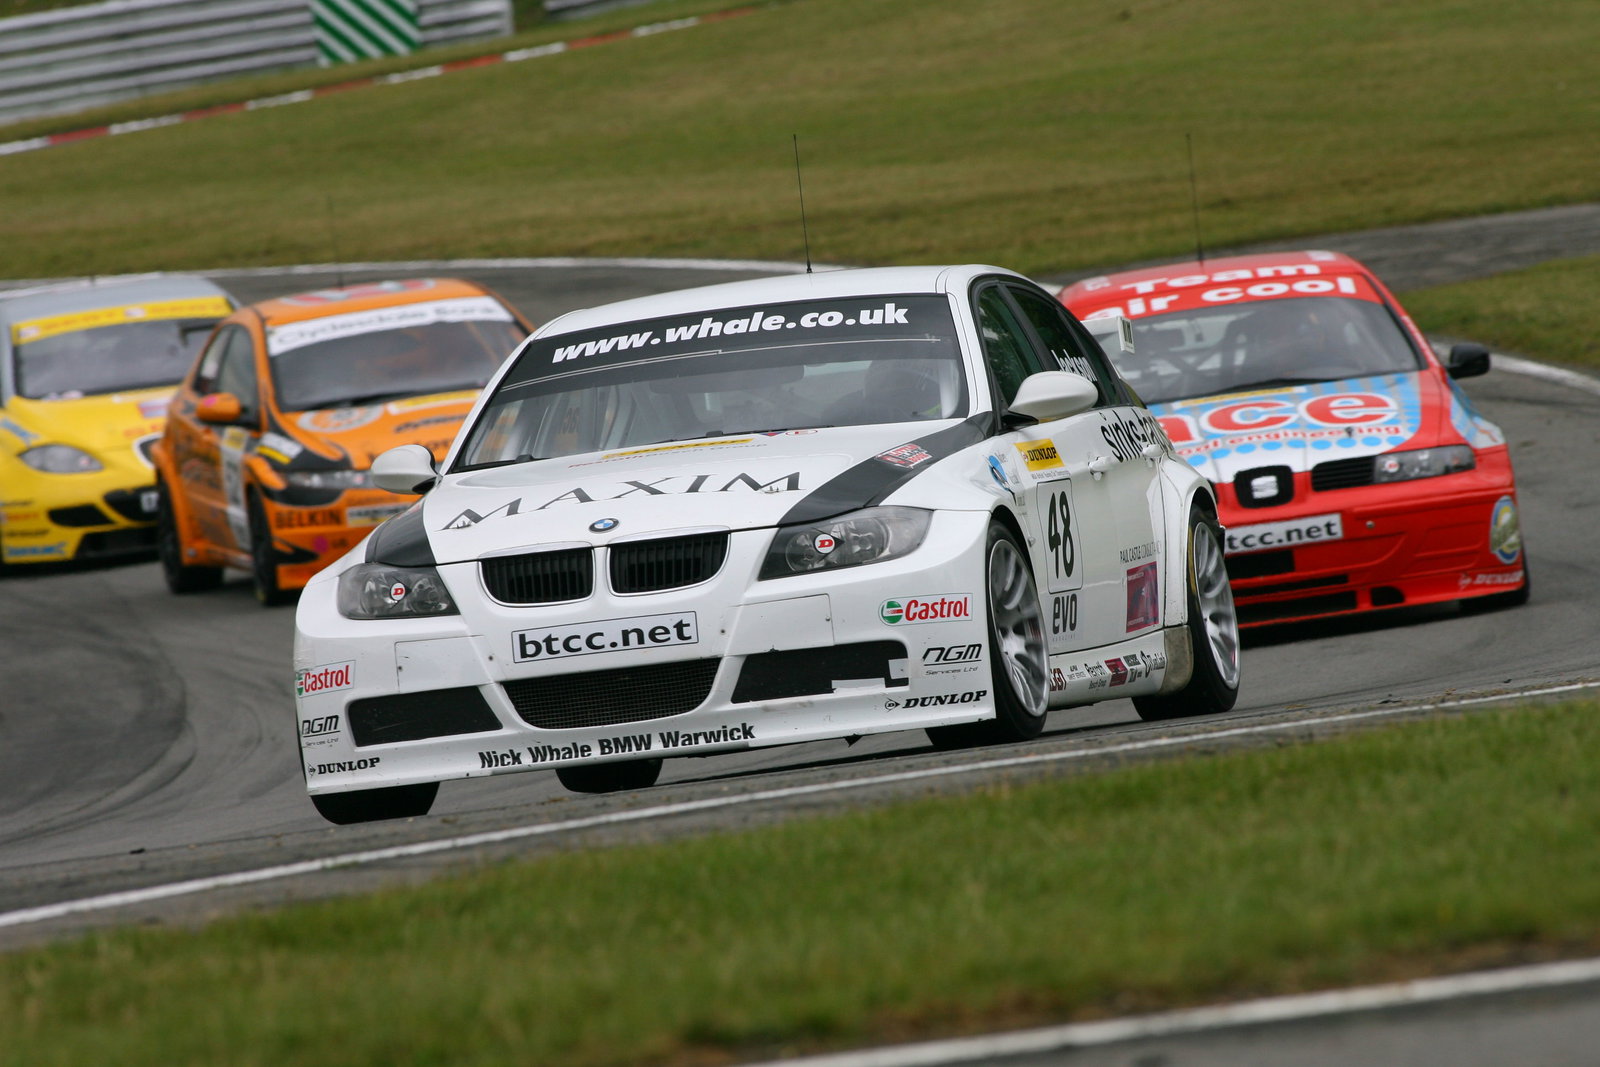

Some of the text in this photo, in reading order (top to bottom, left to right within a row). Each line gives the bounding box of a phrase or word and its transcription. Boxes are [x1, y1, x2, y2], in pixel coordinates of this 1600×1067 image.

[1121, 264, 1320, 294] Team
[1200, 277, 1357, 302] cool
[552, 303, 909, 364] www.whale.co.uk
[1027, 446, 1057, 462] DUNLOP
[435, 472, 806, 531] MAXIM
[275, 509, 343, 529] BELKIN
[1048, 490, 1074, 579] 48
[1226, 520, 1338, 550] tcc.net
[905, 596, 969, 622] Castrol
[1052, 593, 1077, 635] evo
[518, 619, 693, 659] btcc.net
[304, 664, 351, 693] Castrol
[925, 668, 962, 676] Services
[902, 690, 987, 709] DUNLOP
[478, 722, 756, 769] Nick Whale BMW Warwick
[317, 757, 380, 775] DUNLOP
